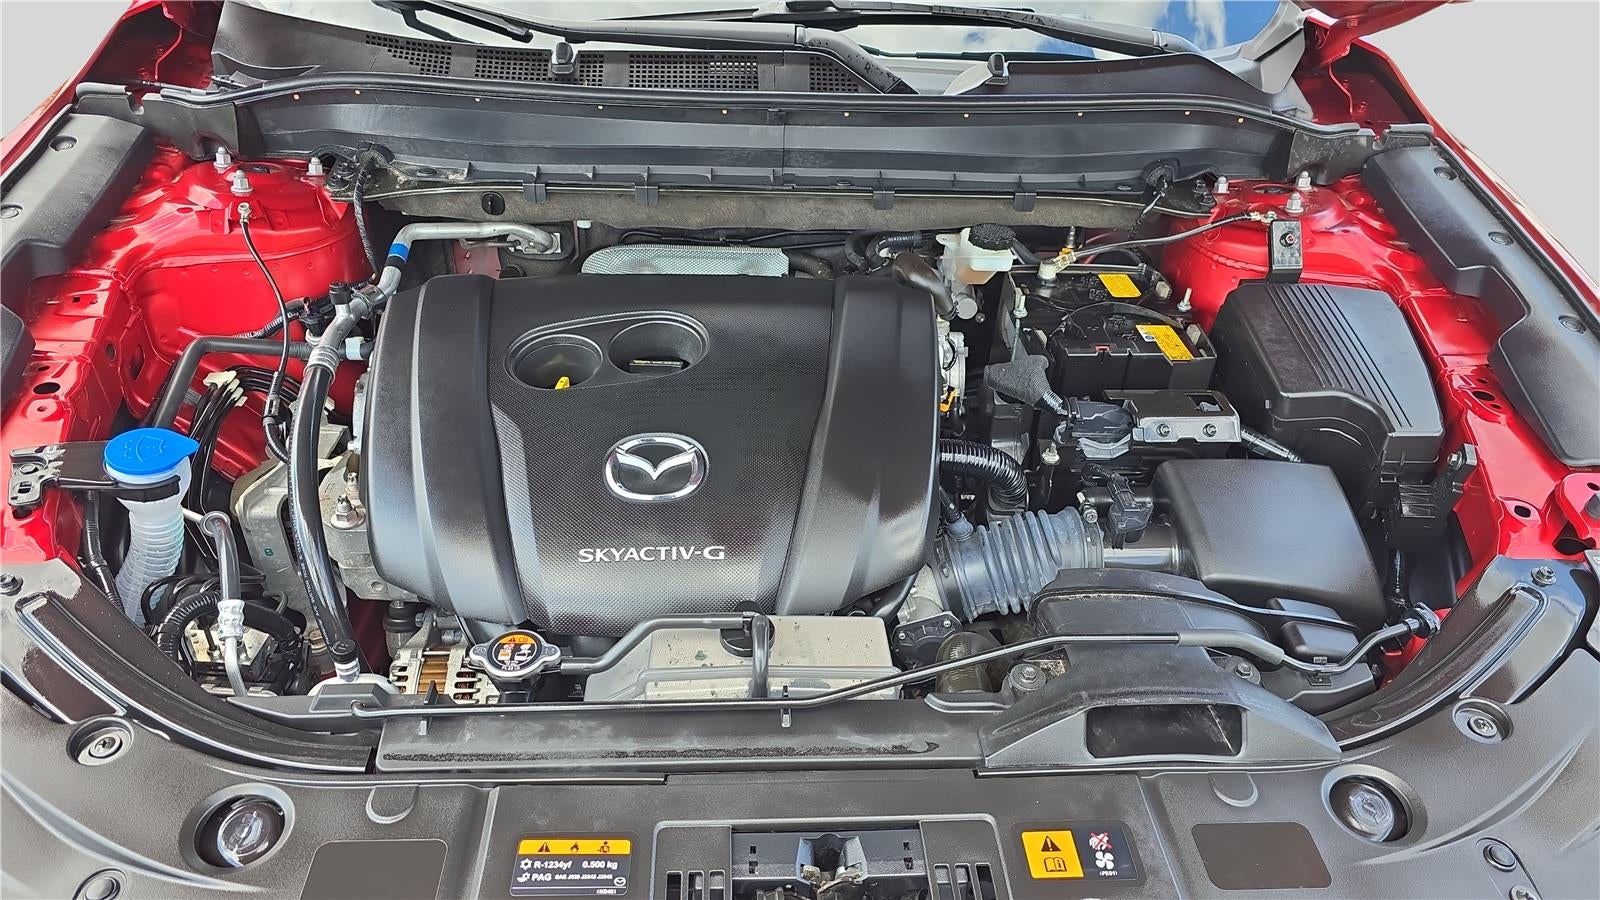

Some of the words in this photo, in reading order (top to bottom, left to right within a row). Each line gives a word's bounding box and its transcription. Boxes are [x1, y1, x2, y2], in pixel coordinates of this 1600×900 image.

[578, 546, 725, 563] SKYACTIV-G
[533, 860, 573, 870] R-1234yf
[582, 861, 606, 869] 0.500
[607, 860, 618, 870] kg
[531, 873, 552, 881] PAG
